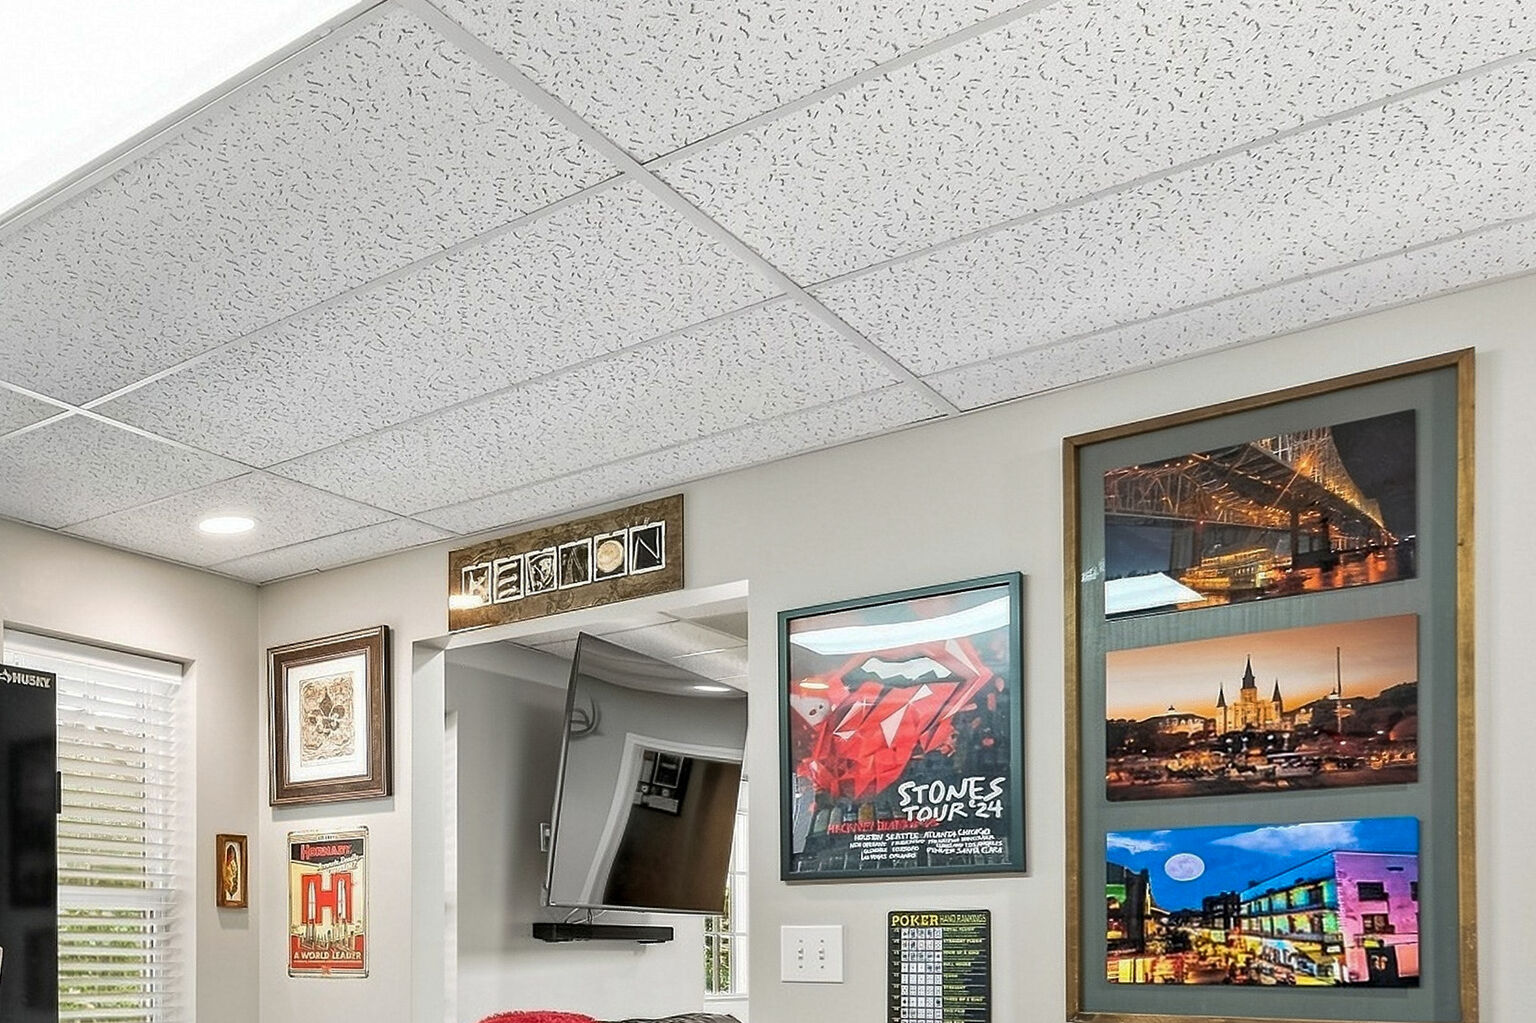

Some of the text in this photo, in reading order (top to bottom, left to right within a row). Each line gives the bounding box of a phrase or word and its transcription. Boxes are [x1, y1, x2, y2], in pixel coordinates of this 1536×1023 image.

[12, 672, 51, 688] HUSKY
[898, 776, 1006, 807] STONES
[901, 802, 968, 822] TOUR
[853, 827, 991, 842] HOUSTON SEATTLE ATLANTA CHICAGO
[300, 844, 353, 860] HORNADY
[955, 846, 981, 855] SANTA
[980, 846, 1004, 854] CLARA
[891, 914, 939, 927] POKER
[293, 951, 362, 960] A WORLD LEADER
